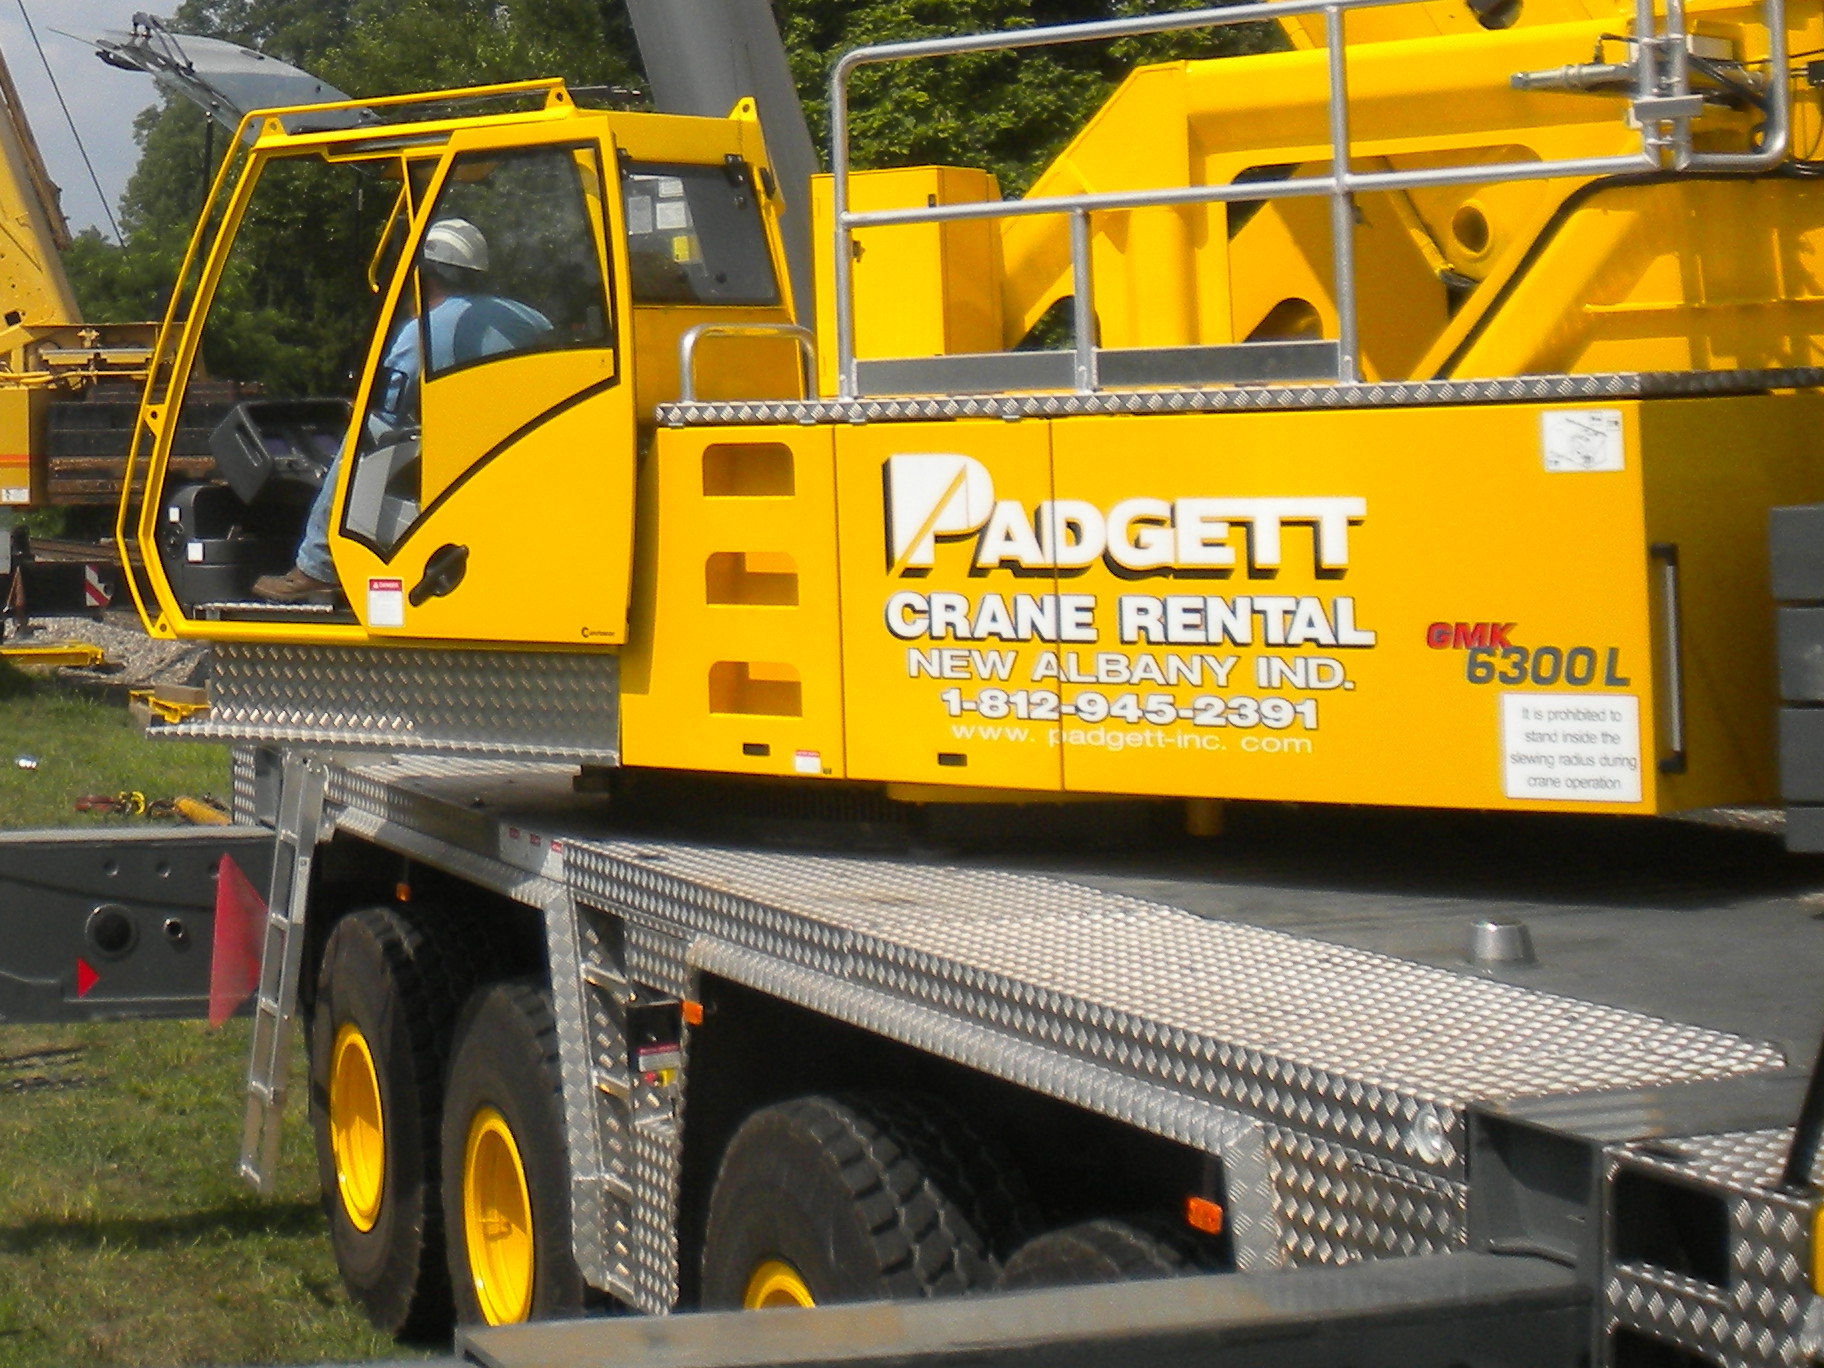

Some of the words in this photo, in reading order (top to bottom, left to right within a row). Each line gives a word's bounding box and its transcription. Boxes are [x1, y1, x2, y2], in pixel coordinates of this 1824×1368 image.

[882, 452, 1367, 582] PADGETT
[885, 591, 1099, 643] CRANE
[1119, 594, 1377, 649] RENTAL
[1426, 621, 1517, 649] GMK
[907, 647, 1018, 681] NEW
[1031, 651, 1240, 687] ALBANY
[1257, 655, 1355, 691] IND.
[941, 687, 1318, 730] 1-812-945-2391
[1521, 706, 1531, 721] It
[1534, 709, 1544, 721] is
[1547, 707, 1607, 723] prohibited
[1610, 709, 1623, 722] to
[1524, 730, 1558, 743] stand
[1562, 730, 1597, 744] inside
[1601, 730, 1621, 744] the
[1510, 752, 1555, 769] slewing
[1558, 753, 1596, 767] radius
[1599, 754, 1637, 771] during
[1527, 776, 1561, 788] crane
[1564, 776, 1622, 790] operation
